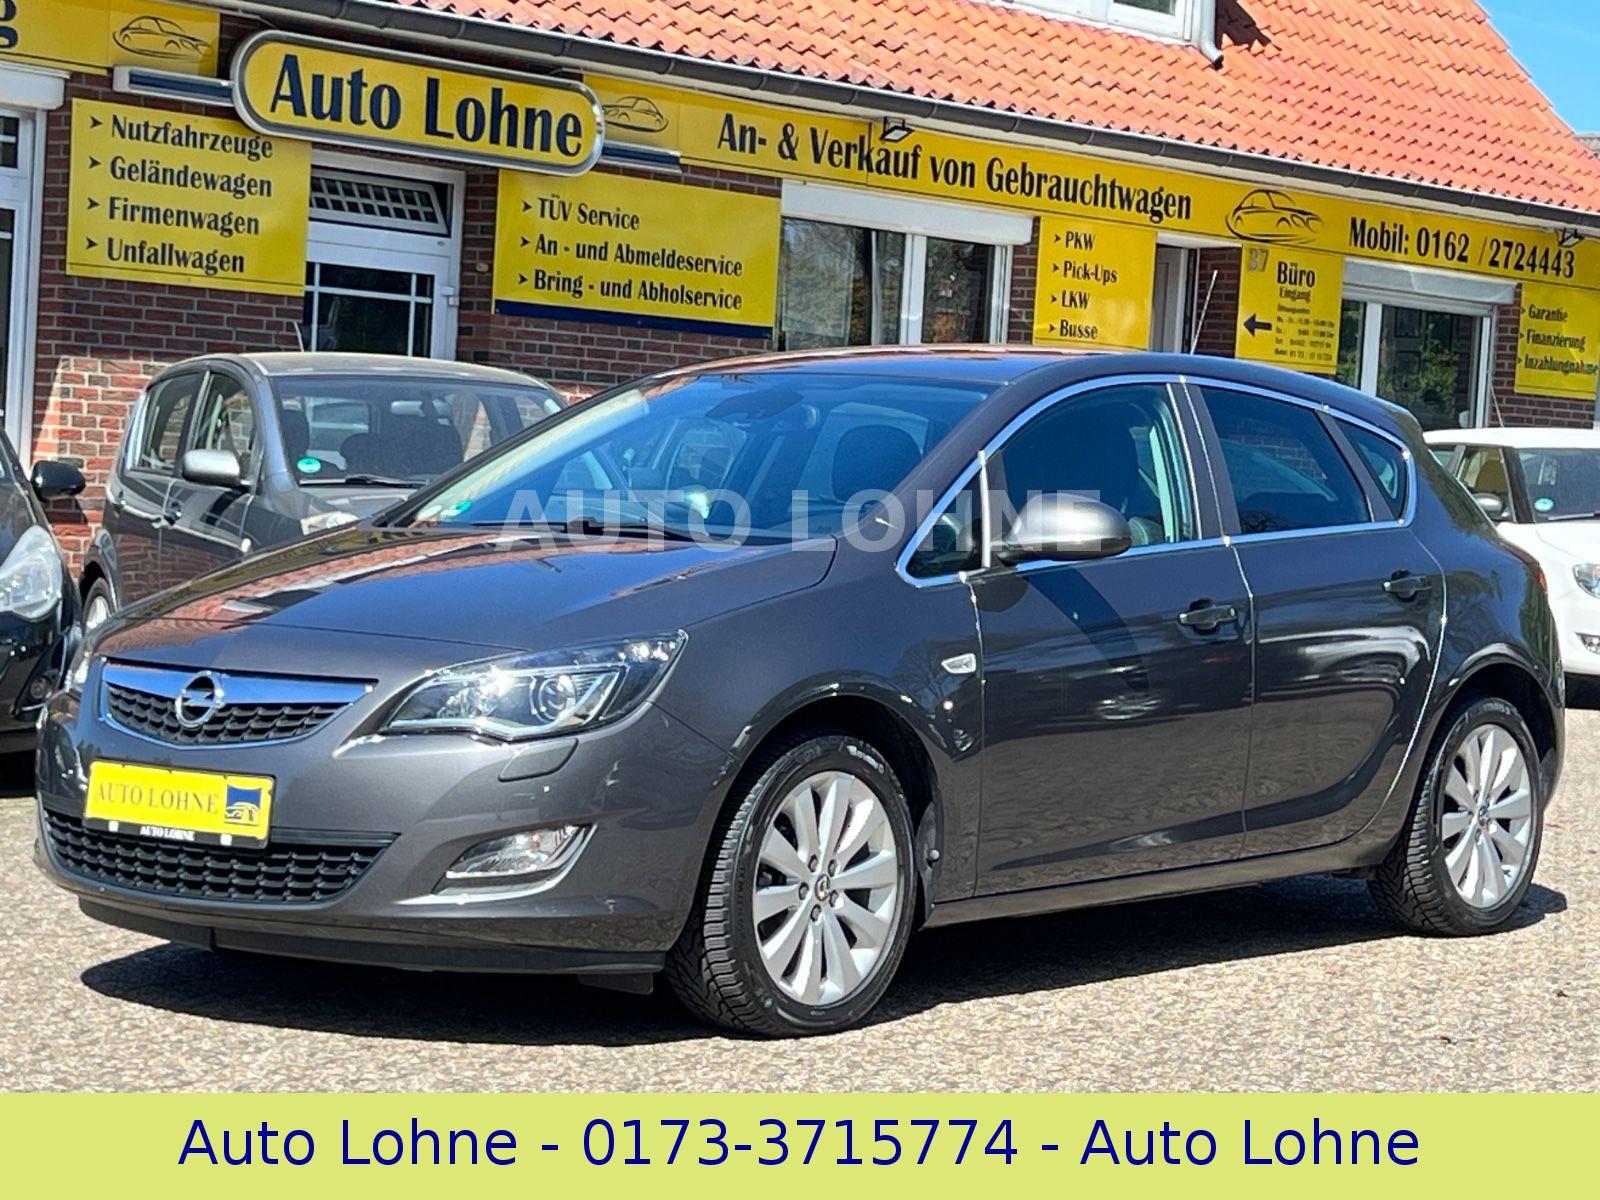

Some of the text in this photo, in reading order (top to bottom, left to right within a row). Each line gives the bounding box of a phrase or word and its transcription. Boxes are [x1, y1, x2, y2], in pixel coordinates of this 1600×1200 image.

[270, 53, 582, 156] Auto Lohne
[112, 114, 273, 161] Nutzfahrzeuge
[110, 155, 272, 199] Geländewagen
[717, 113, 1191, 223] An- & Verkauf von Gebrauchtwagen
[109, 196, 259, 237] Firmenwagen
[537, 194, 639, 230] TÜV Service
[107, 237, 244, 275] Unfallwagen
[535, 233, 557, 255] An
[576, 241, 608, 261] und
[614, 243, 742, 277] Abmeldeservice
[1065, 231, 1096, 250] PKW
[1350, 217, 1409, 255] Mobil:
[1417, 227, 1469, 262] 0162
[534, 269, 583, 298] Bring
[600, 279, 632, 299] und
[637, 280, 742, 310] Abholservice
[1063, 260, 1117, 286] Pick-Ups
[1277, 261, 1315, 288] Büro
[1061, 289, 1090, 309] LKW
[1528, 304, 1568, 322] Garantie
[1059, 319, 1098, 339] Busse
[1527, 329, 1586, 353] Finanzierung
[95, 782, 219, 814] AUTO LOHNE
[140, 825, 164, 838] AUTO
